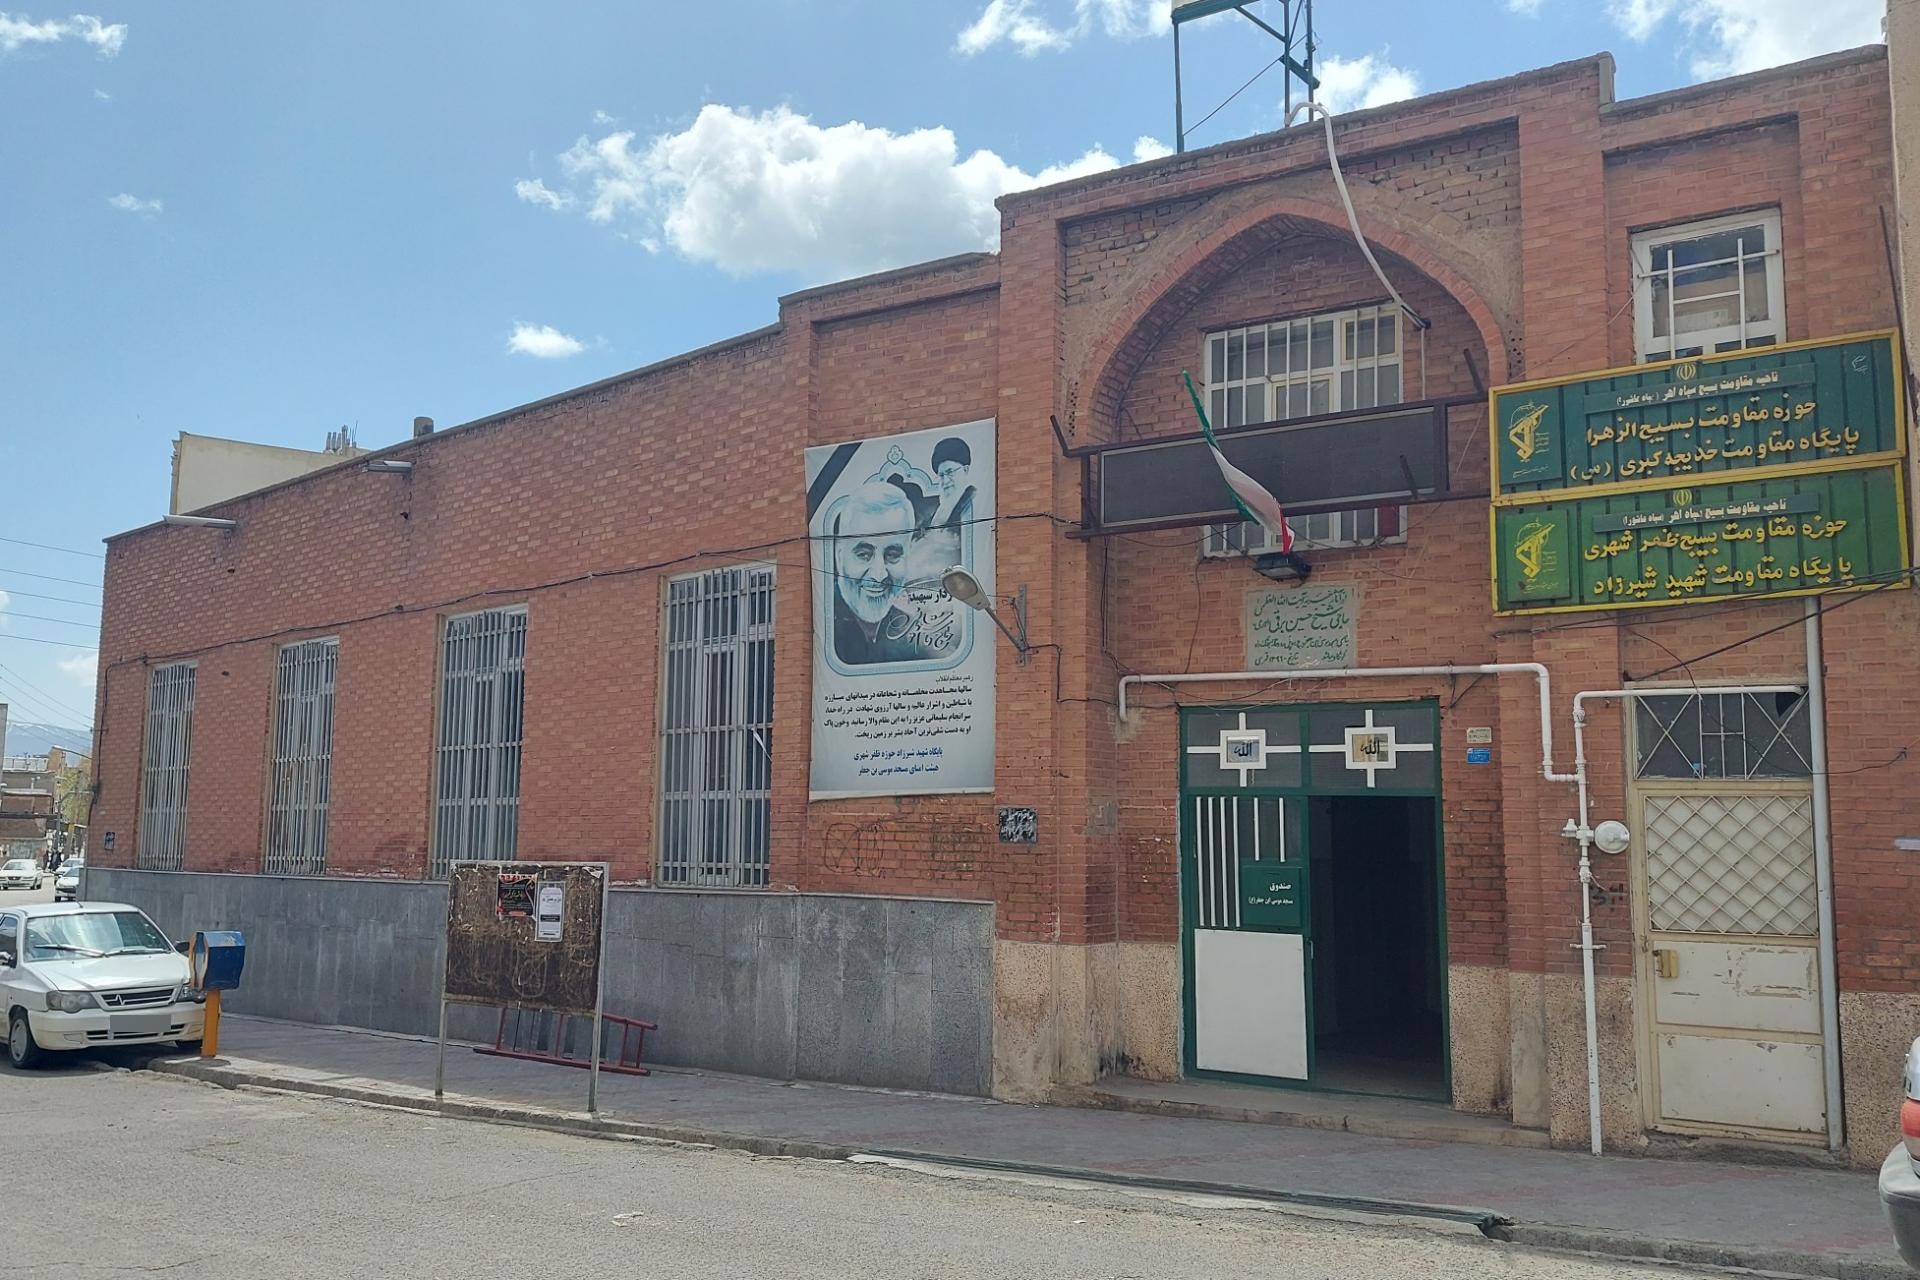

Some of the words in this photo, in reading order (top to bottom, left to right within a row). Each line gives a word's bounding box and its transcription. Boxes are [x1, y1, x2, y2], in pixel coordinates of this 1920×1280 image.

[1699, 383, 1719, 396] بسیج
[1719, 374, 1754, 391] مقاومت
[1697, 395, 1770, 428] مقاومت
[1772, 391, 1817, 422] حوزه
[1585, 415, 1637, 448] الزهرا
[1638, 414, 1695, 443] بسیج
[1798, 425, 1860, 456] پایگاه
[1663, 437, 1719, 472] خدیجه
[1721, 430, 1795, 460] مقاومت
[1618, 450, 1663, 478] کبری
[1704, 506, 1725, 519] بسیج
[1726, 501, 1761, 517] مقاومت
[1639, 527, 1681, 552] ظفر
[1721, 517, 1796, 543] مقاومت
[1801, 515, 1848, 540] حوزه
[1584, 530, 1634, 561] شهری
[1679, 529, 1719, 558] بسیج
[1664, 563, 1709, 598] شهید
[1711, 555, 1784, 587] مقاومت
[1787, 556, 1856, 587] پایگاه
[1233, 742, 1252, 757] الله
[1359, 739, 1380, 755] الله
[1269, 882, 1292, 892] صندوق
